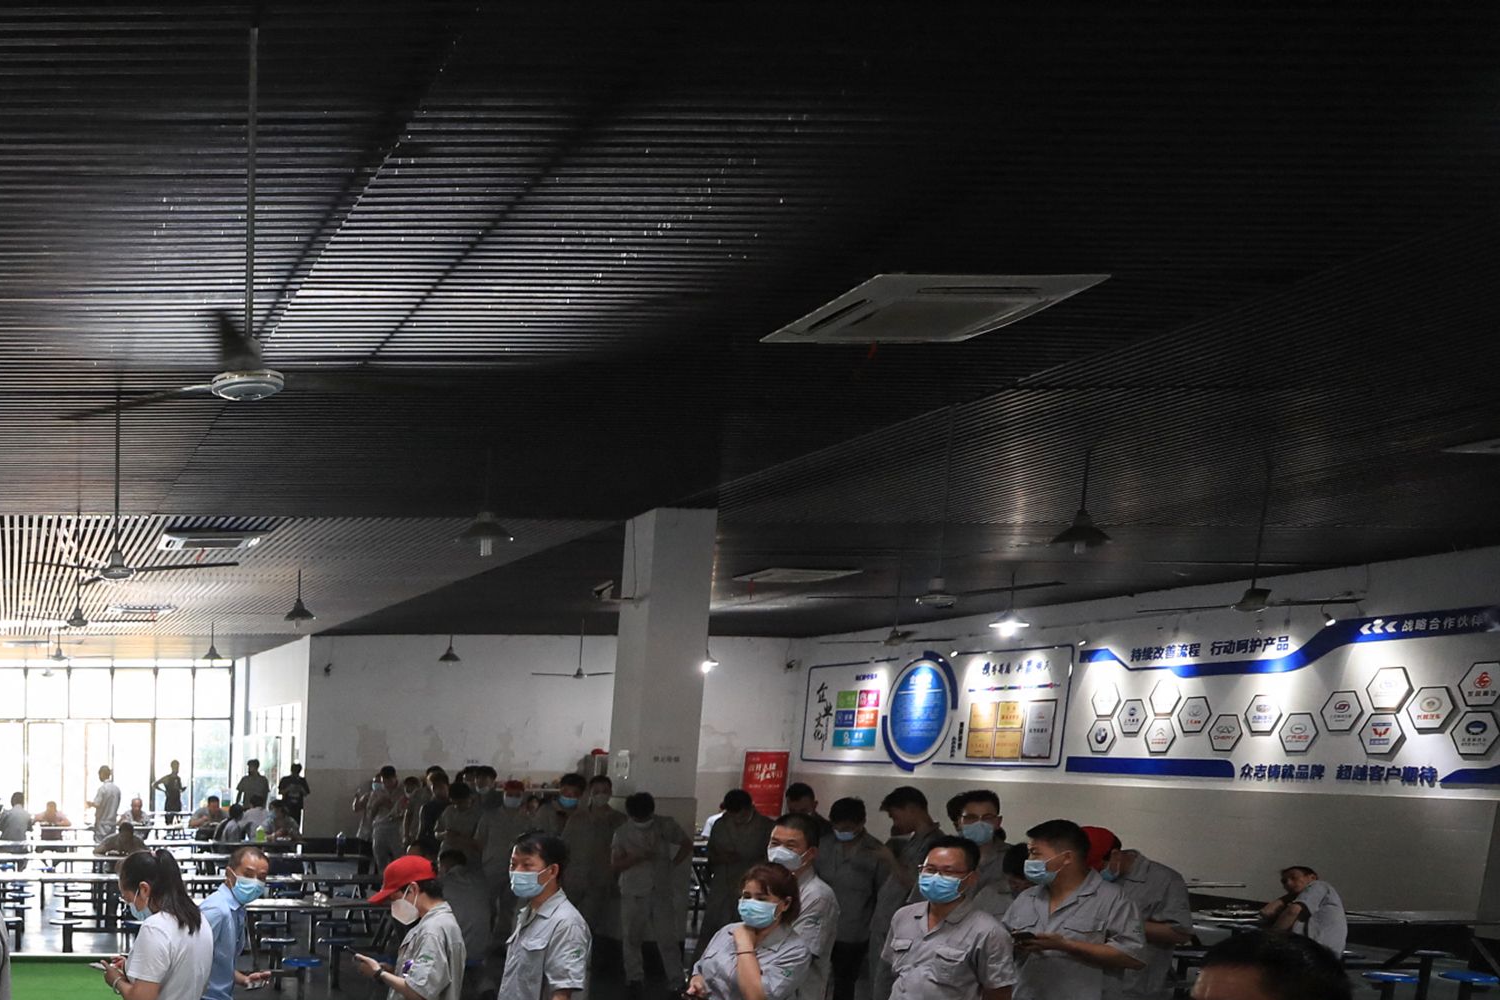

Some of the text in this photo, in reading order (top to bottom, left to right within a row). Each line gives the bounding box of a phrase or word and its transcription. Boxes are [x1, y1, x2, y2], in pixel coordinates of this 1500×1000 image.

[1401, 615, 1484, 632] 战略合作伙伴
[1130, 635, 1289, 661] 持续改善流程 行动呵护产品
[1240, 763, 1438, 786] 众志铸就品牌 超越客户期待
